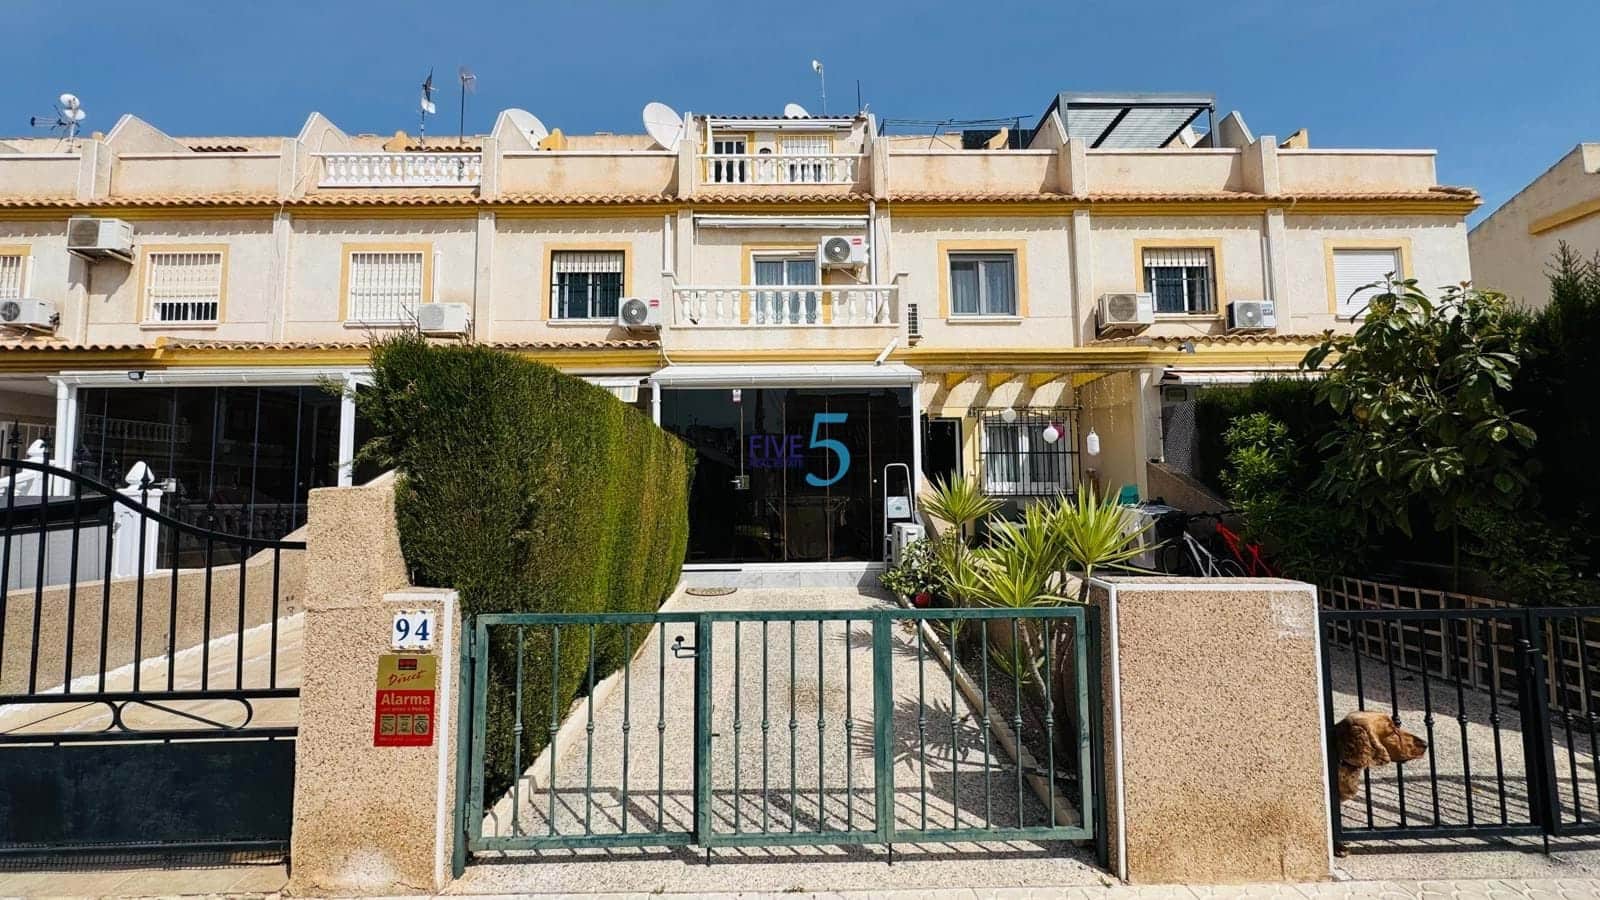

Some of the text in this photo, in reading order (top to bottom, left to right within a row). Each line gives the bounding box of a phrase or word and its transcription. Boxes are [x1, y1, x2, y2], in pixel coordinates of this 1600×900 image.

[396, 618, 430, 641] 94
[388, 670, 426, 686] Direct
[381, 693, 431, 705] Alarma
